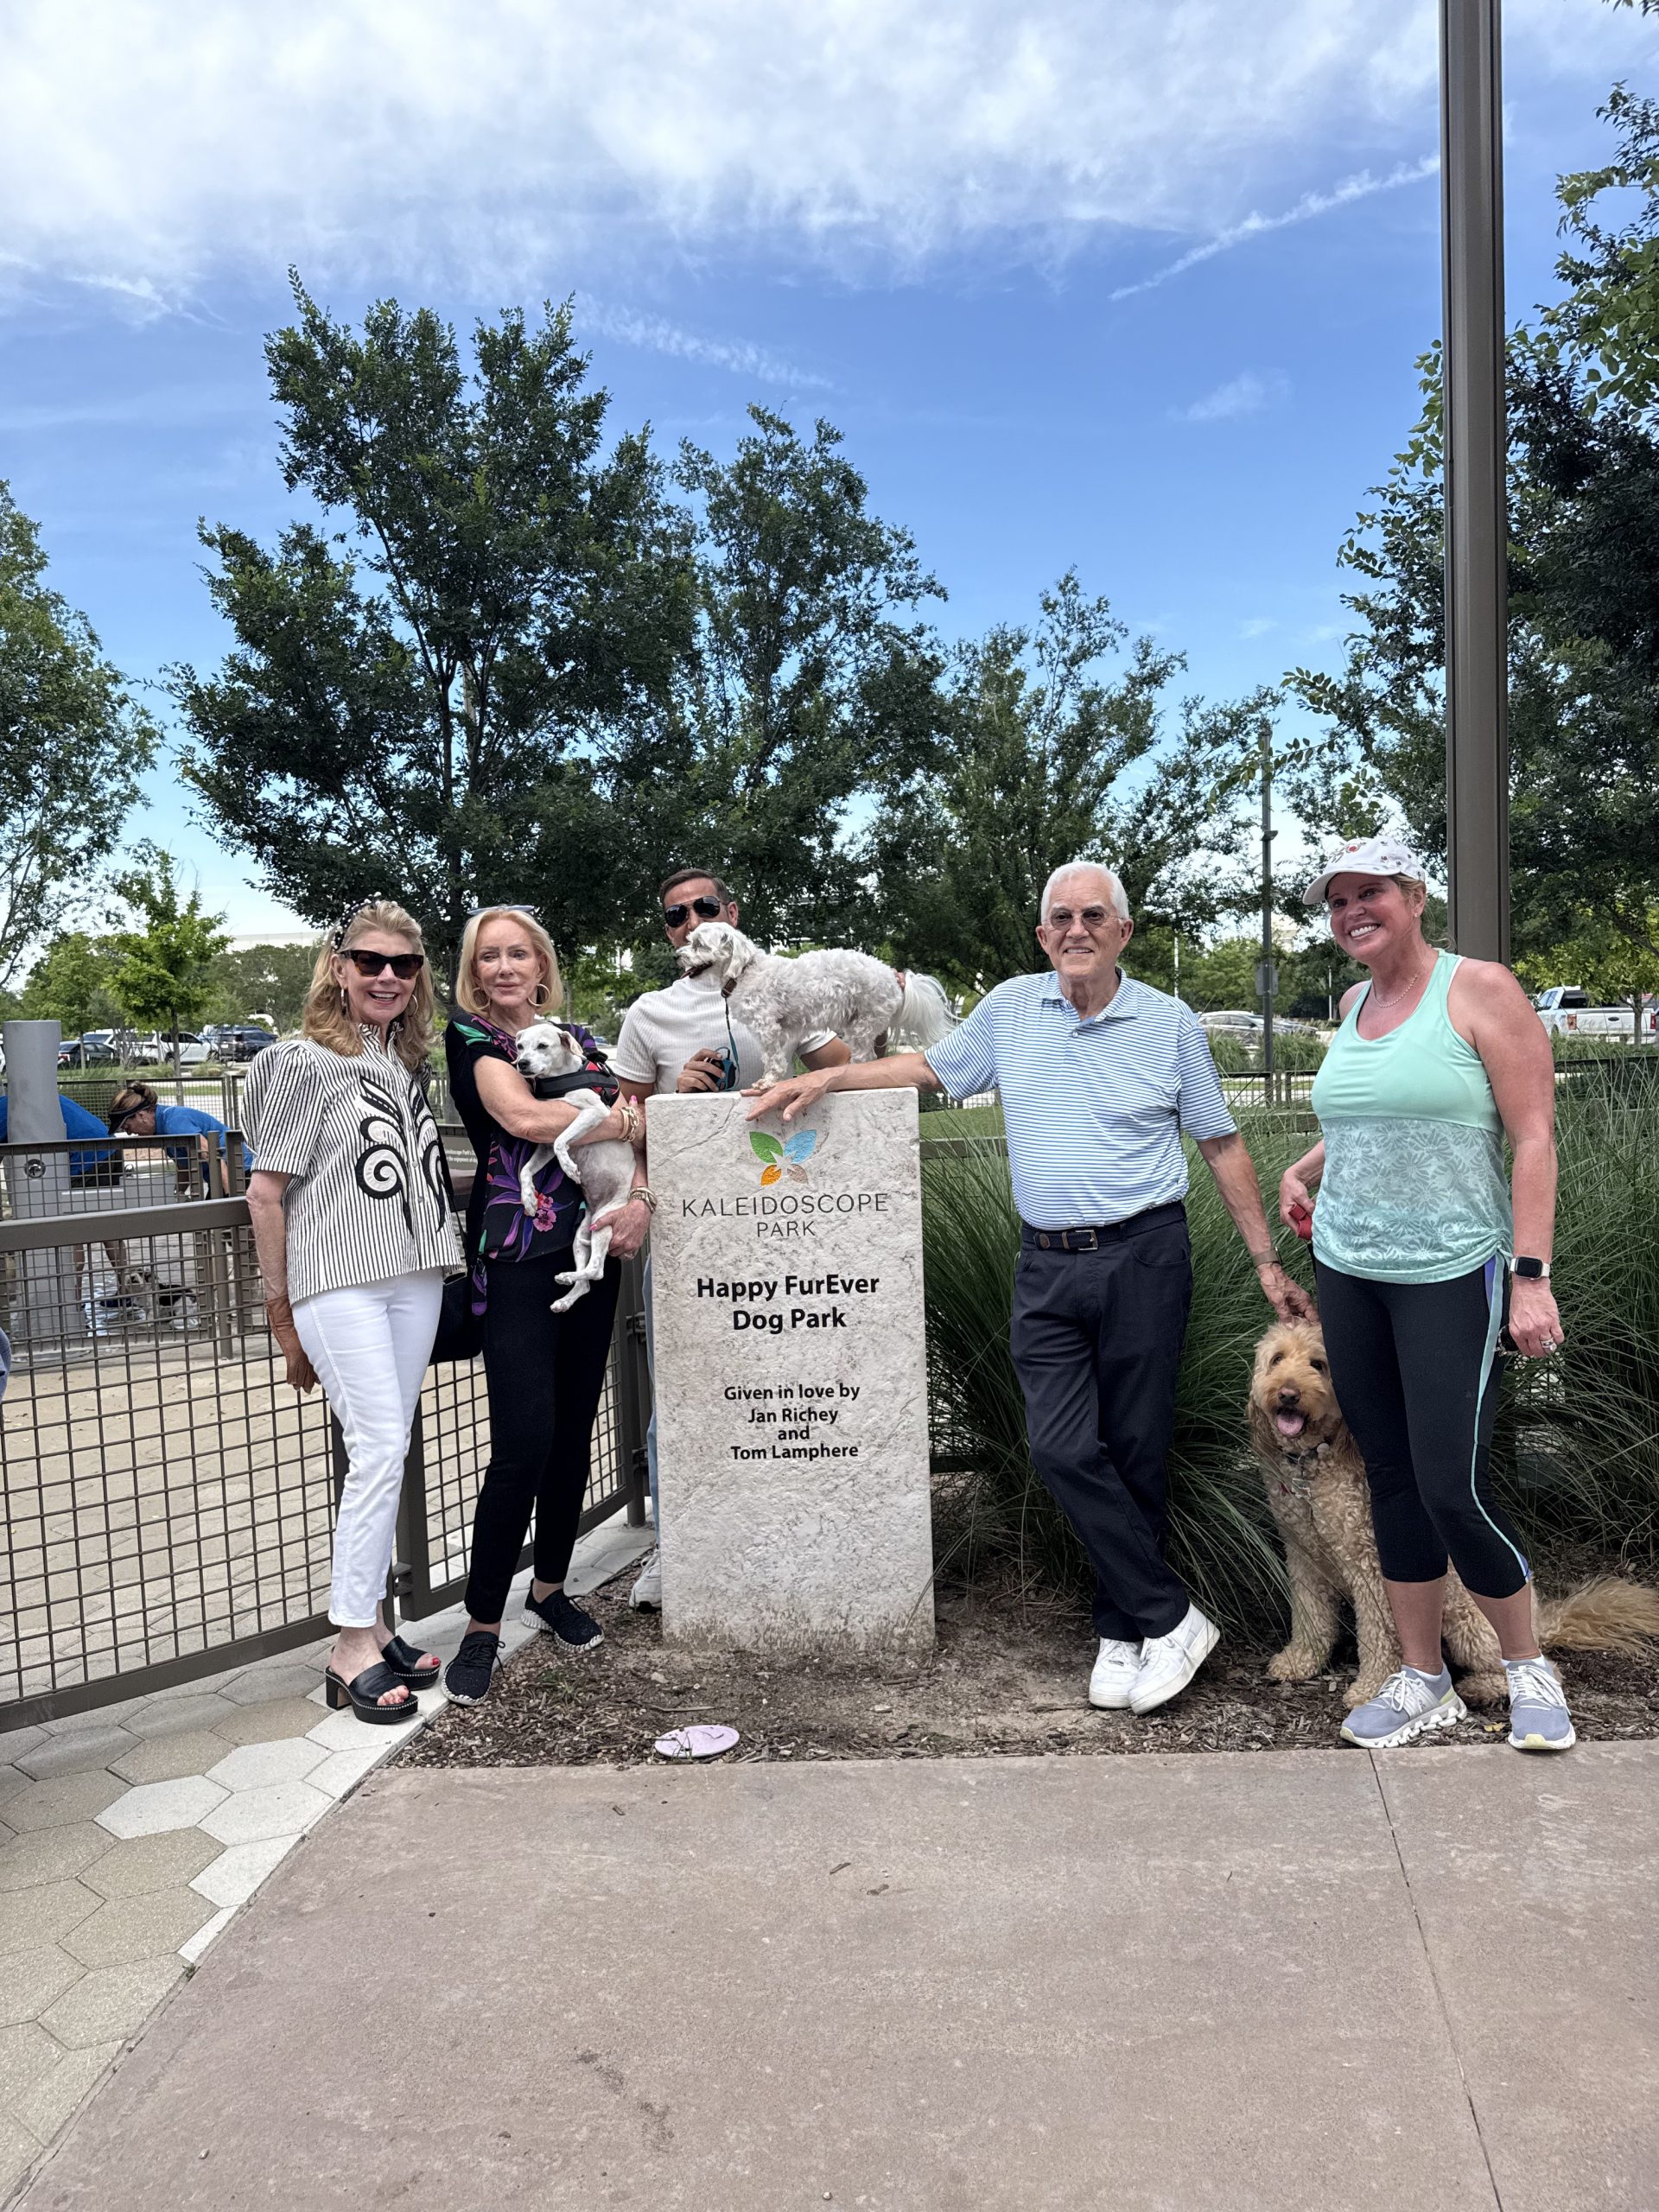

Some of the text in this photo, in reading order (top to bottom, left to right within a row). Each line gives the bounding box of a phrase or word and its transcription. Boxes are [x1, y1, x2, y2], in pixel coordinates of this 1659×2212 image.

[683, 1193, 889, 1217] KALEIDOSCOPE
[757, 1220, 816, 1237] PARK
[697, 1274, 880, 1302] Happy FurEver
[733, 1306, 847, 1334] Dog Park
[724, 1382, 860, 1401] Given in love by
[748, 1407, 838, 1424] Jan Richey
[778, 1426, 810, 1440] and
[730, 1443, 859, 1461] Tom Lamphere
